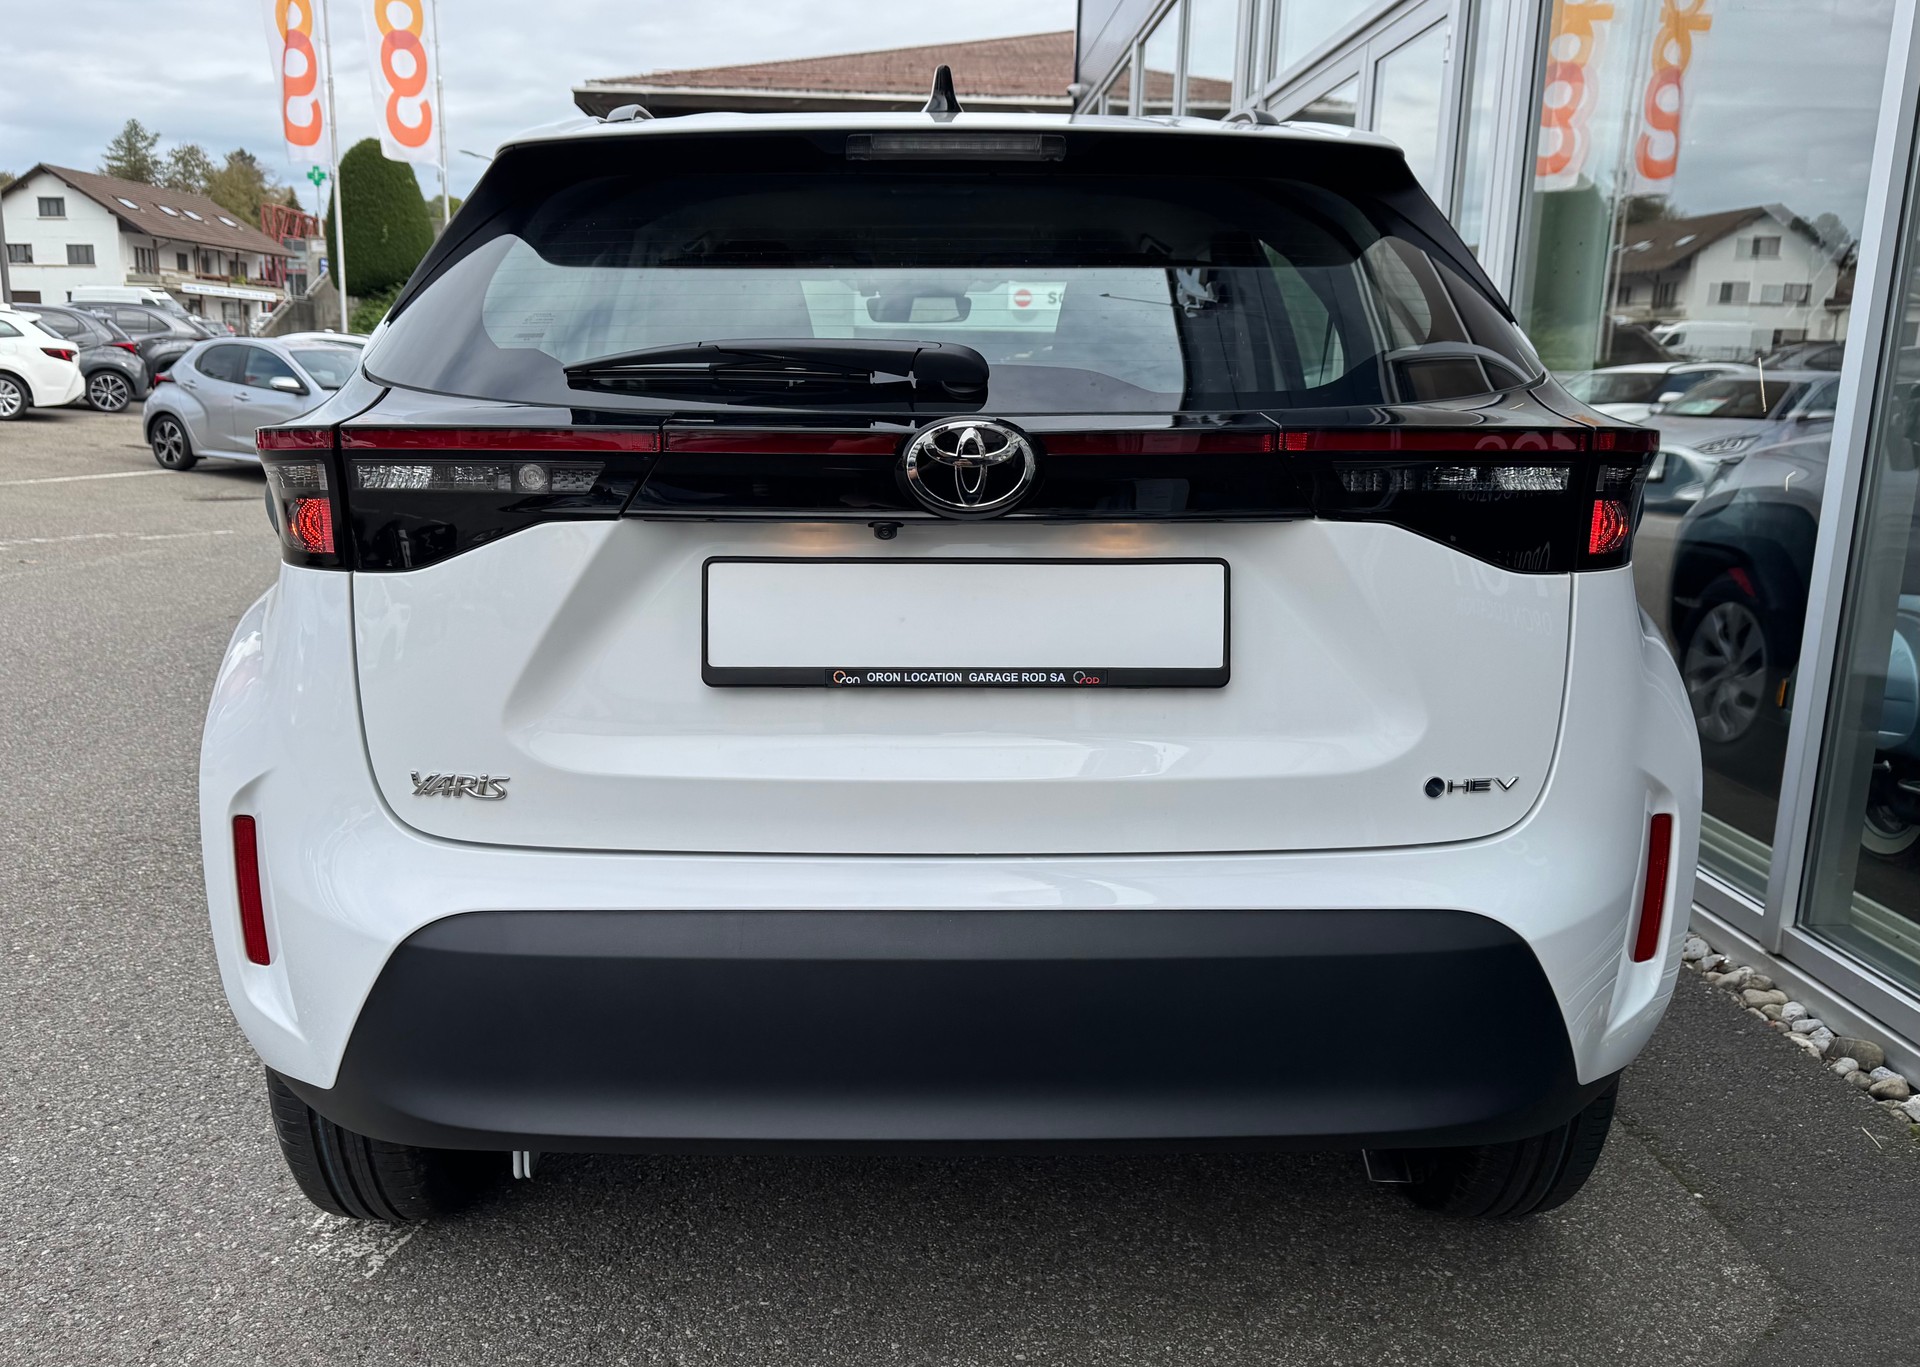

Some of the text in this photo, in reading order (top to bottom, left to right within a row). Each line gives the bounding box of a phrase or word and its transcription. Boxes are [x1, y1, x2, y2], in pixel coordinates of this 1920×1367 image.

[866, 672, 900, 683] ORON
[904, 672, 963, 683] LOCATION
[968, 672, 1018, 683] GARAGE
[1021, 672, 1047, 683] ROD
[1049, 672, 1066, 683] SA
[1447, 776, 1520, 795] HEV
